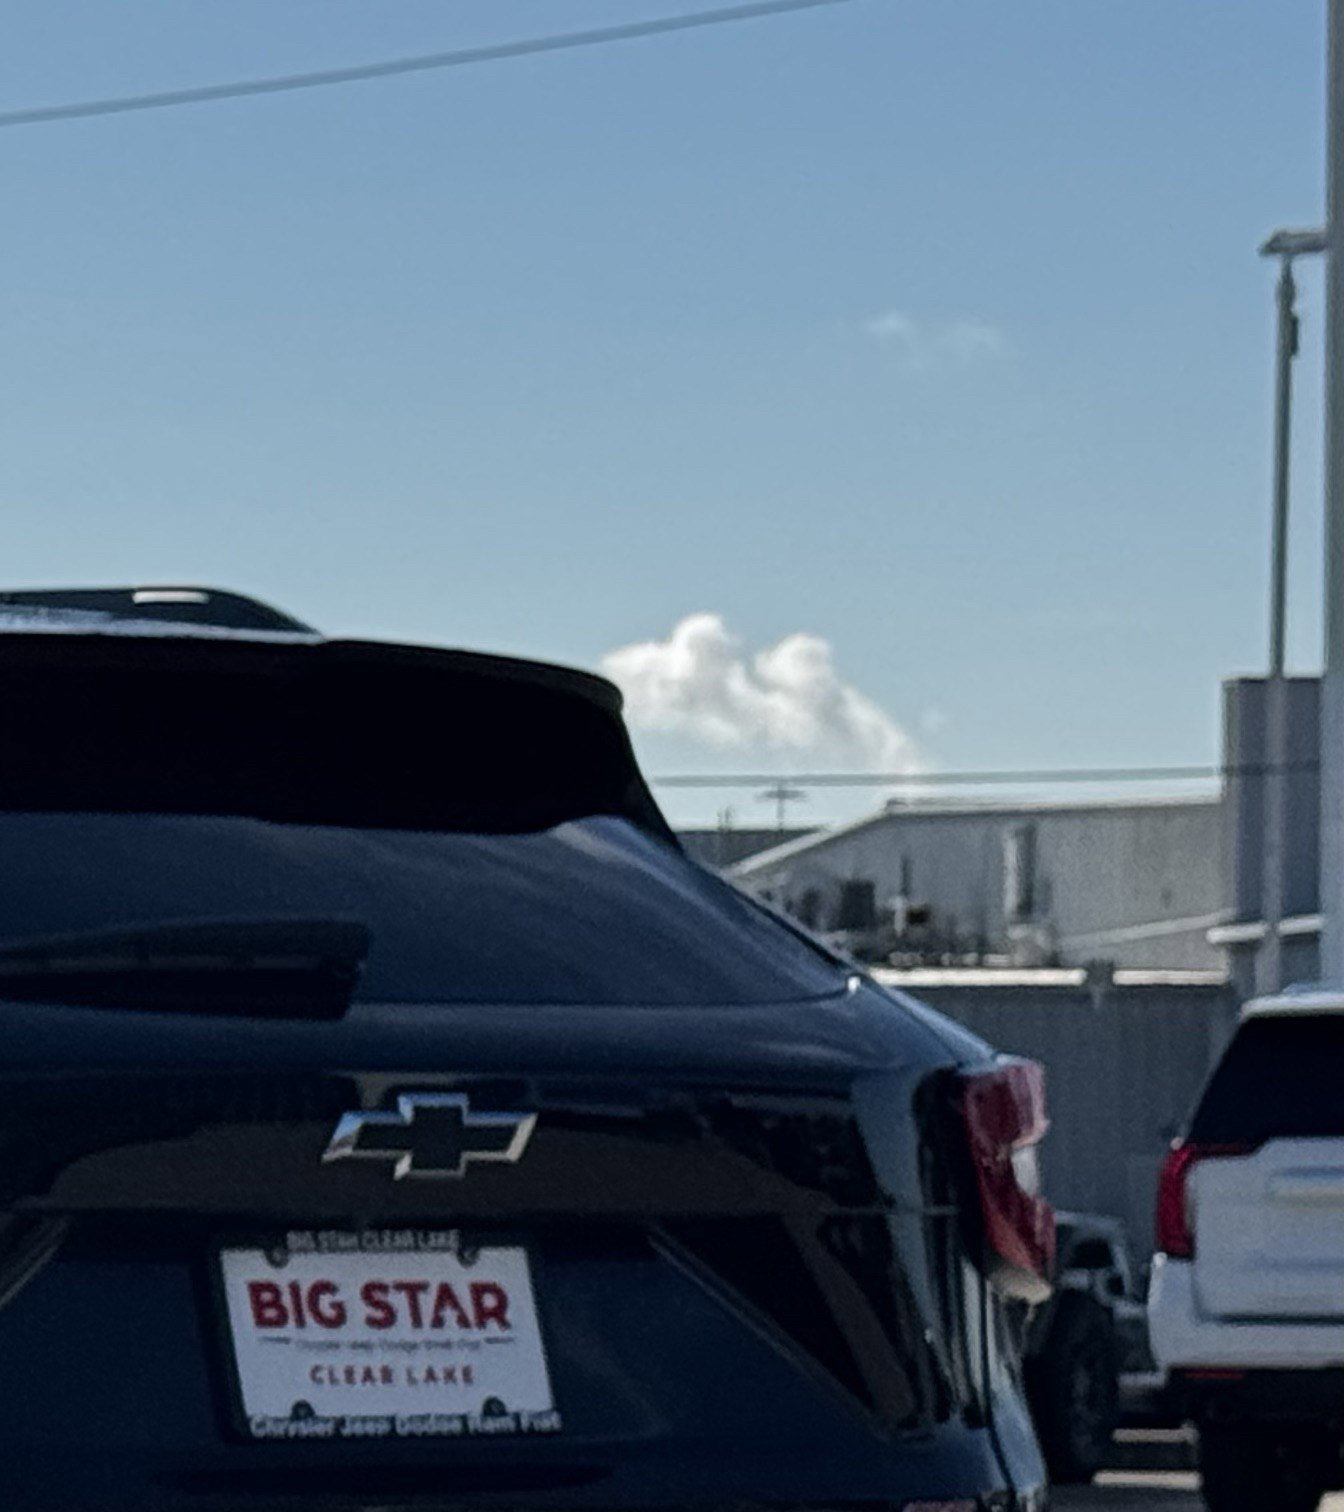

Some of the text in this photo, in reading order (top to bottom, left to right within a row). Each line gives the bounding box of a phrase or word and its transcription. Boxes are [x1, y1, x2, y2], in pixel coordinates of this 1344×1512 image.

[247, 1279, 512, 1331] BIG STAR
[309, 1364, 474, 1386] CLEAR LAKE
